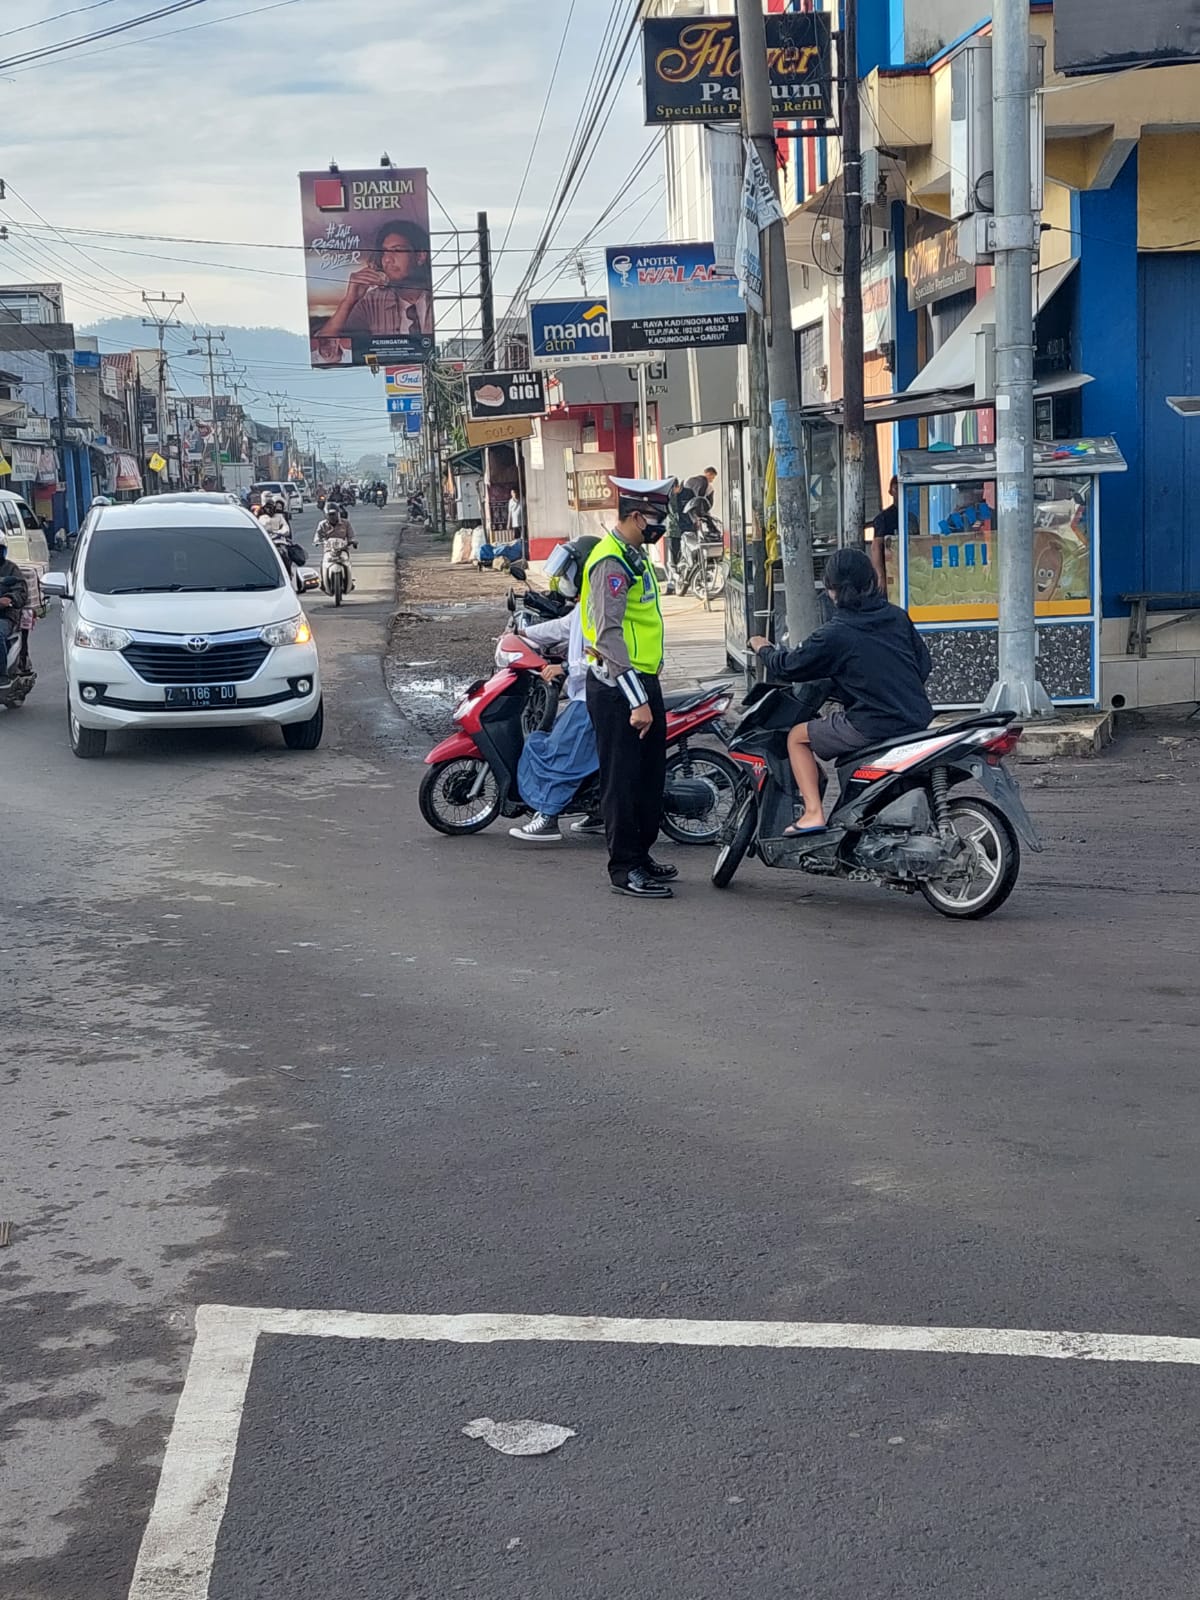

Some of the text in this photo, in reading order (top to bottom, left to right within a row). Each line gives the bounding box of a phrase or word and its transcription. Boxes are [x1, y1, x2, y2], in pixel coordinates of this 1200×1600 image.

[700, 82, 822, 101] Paum
[656, 103, 725, 118] Specialist
[783, 99, 822, 112] Refill
[352, 179, 414, 196] DJARUM
[353, 195, 401, 210] SUPER
[636, 256, 677, 267] APOTEK
[643, 320, 663, 328] RAYA
[664, 317, 712, 327] KADUNGORA
[545, 338, 576, 352] atm
[648, 335, 695, 344] KADUNGORA
[700, 333, 725, 342] GARUT
[512, 373, 537, 385] AHLI
[508, 383, 541, 401] GIGI
[166, 686, 234, 701] Z 1186 DU
